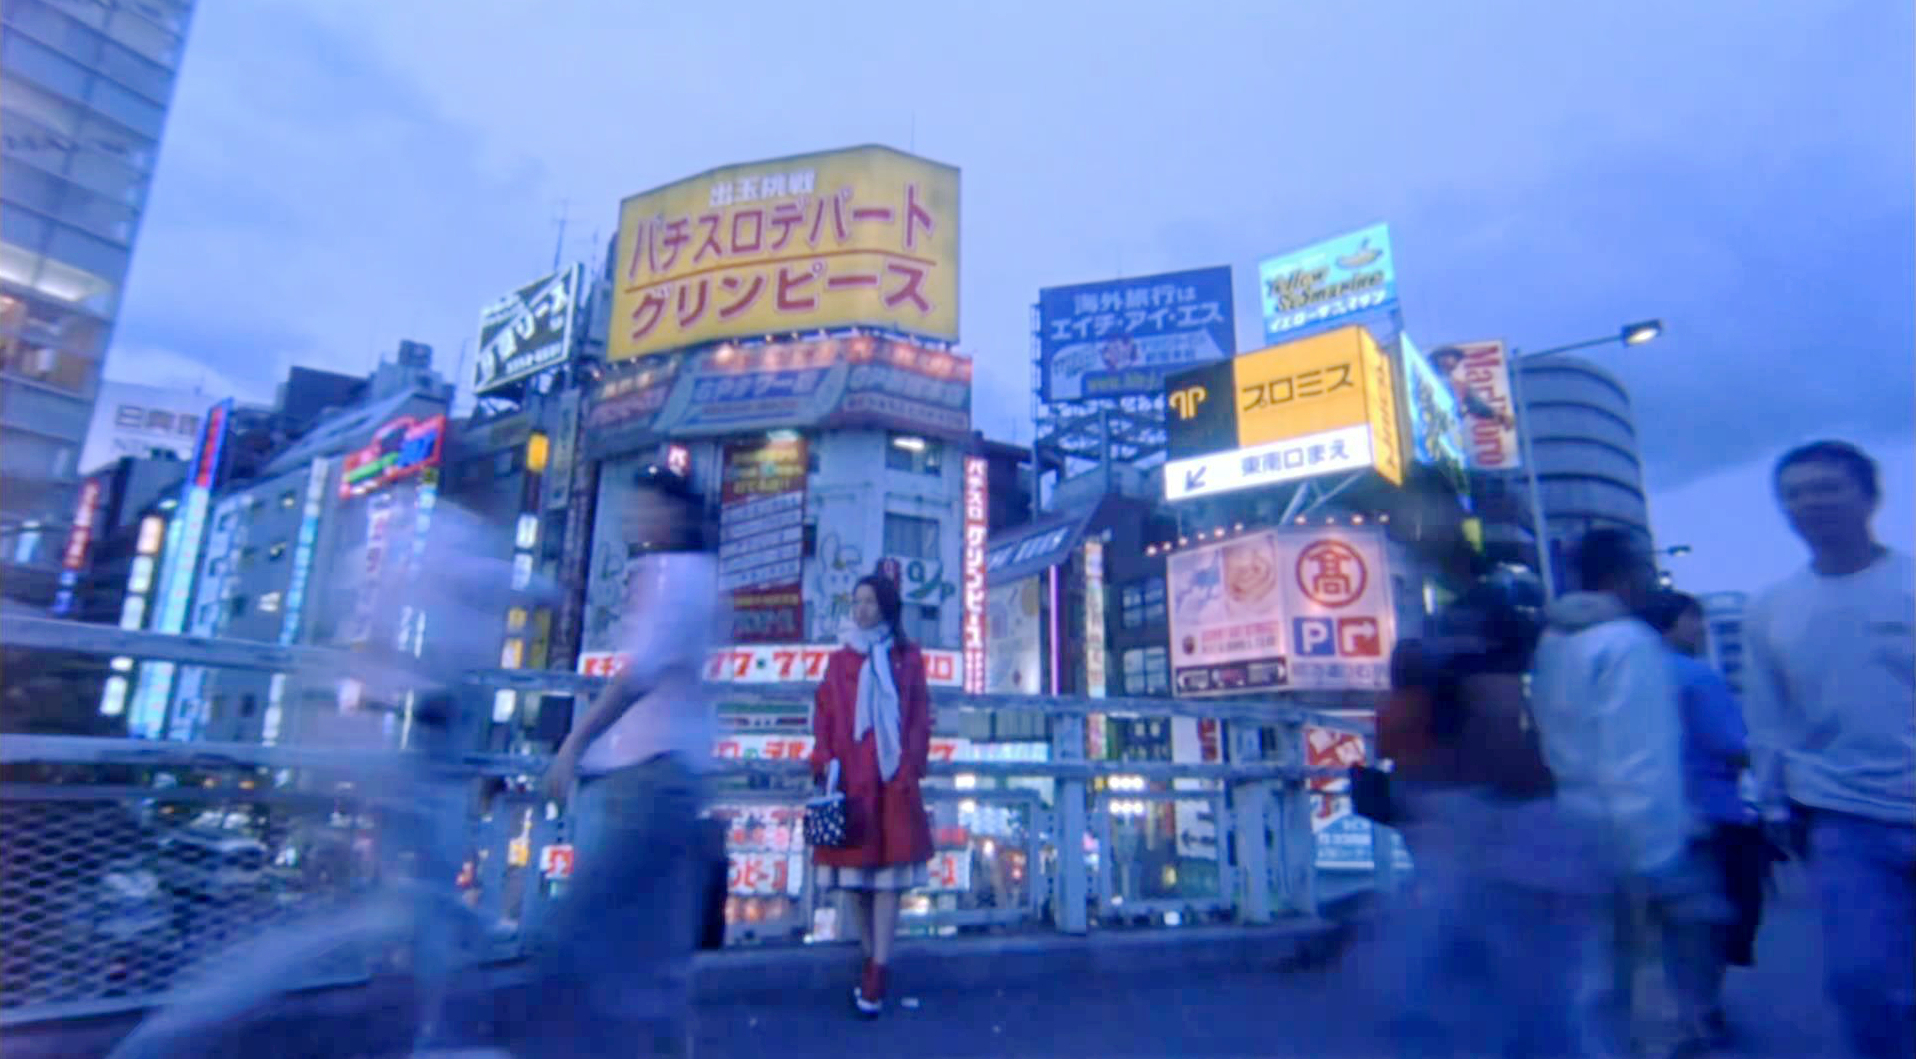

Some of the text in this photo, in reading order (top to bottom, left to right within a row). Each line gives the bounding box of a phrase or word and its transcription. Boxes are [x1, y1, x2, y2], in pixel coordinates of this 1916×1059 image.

[628, 181, 936, 281] パチスロデパート
[631, 260, 931, 341] グリンピース
[1074, 284, 1197, 316] 海外旅行は
[1050, 302, 1224, 340] エイチ・アイ・エス
[1241, 363, 1354, 412] プロミス
[1241, 439, 1350, 477] 東南口まえ
[1301, 621, 1328, 654] P
